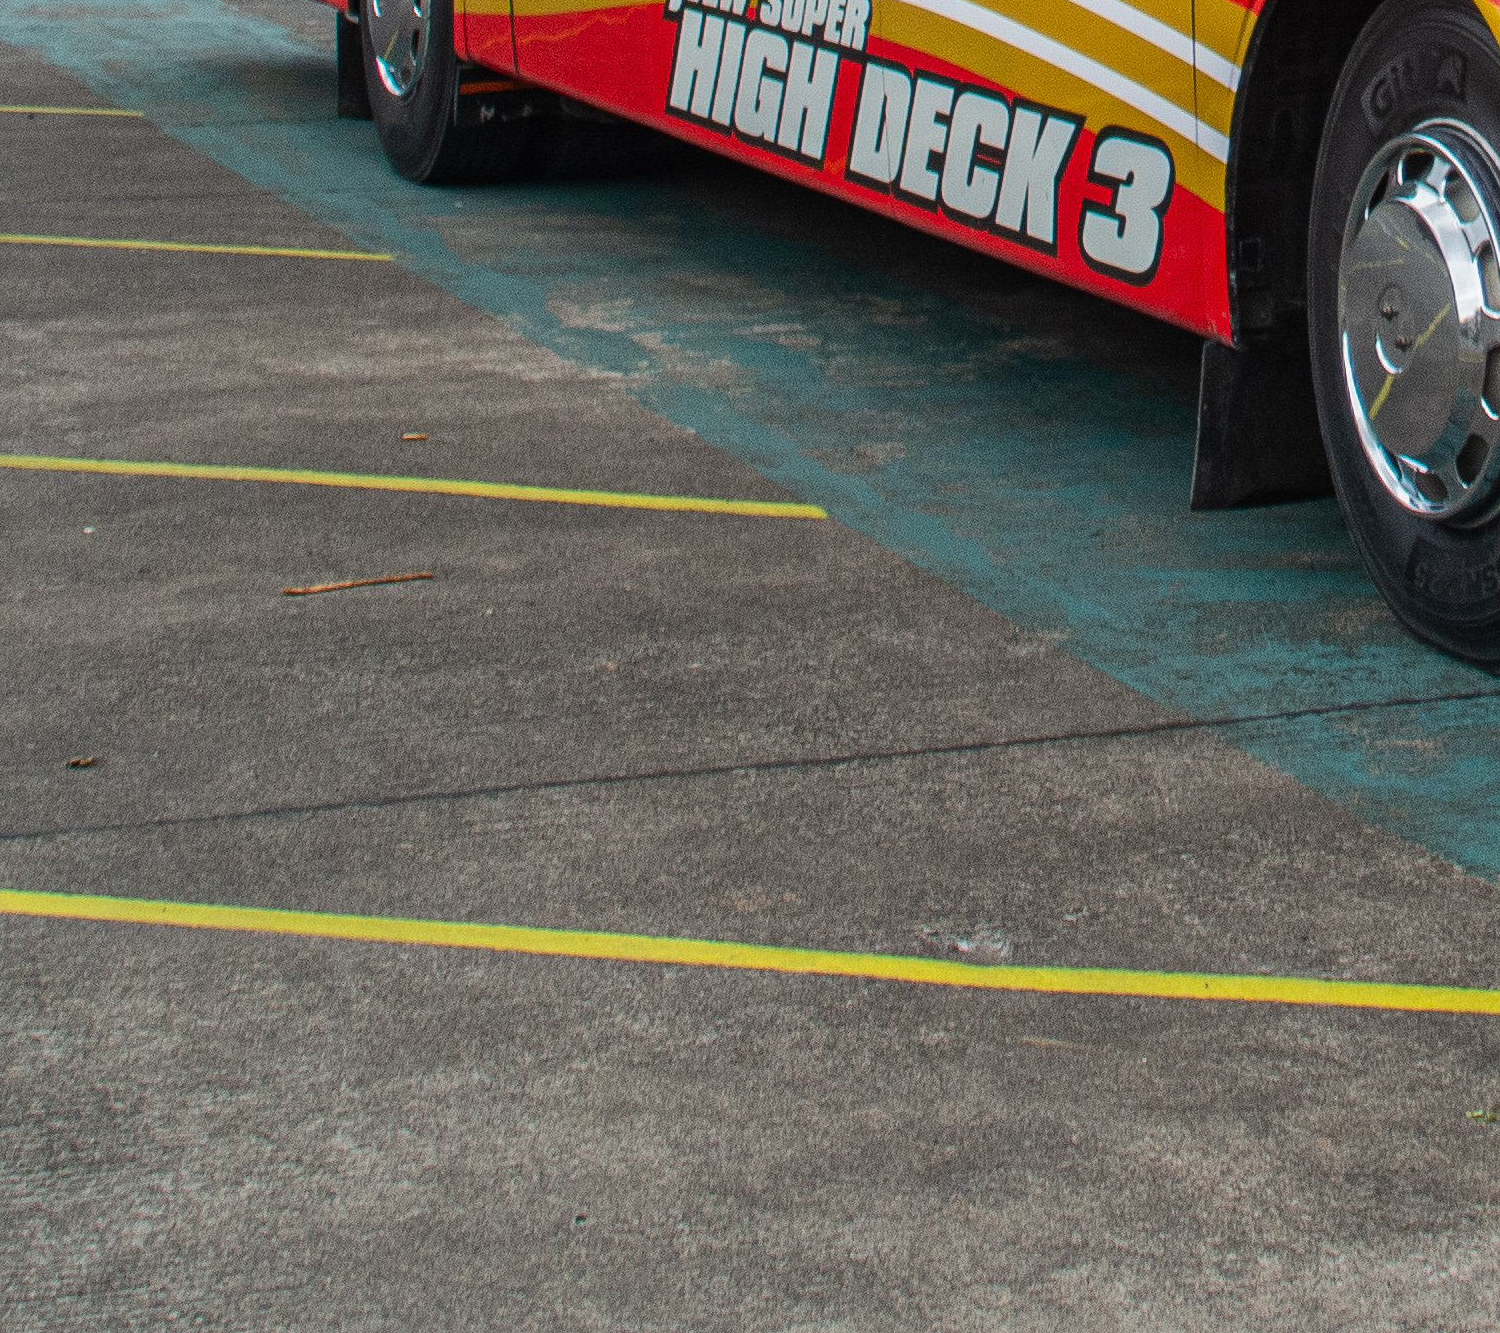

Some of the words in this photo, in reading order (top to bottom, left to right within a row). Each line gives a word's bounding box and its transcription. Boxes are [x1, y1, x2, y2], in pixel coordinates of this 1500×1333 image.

[666, 10, 840, 168] HIGH
[846, 60, 1087, 256] DECK
[1080, 125, 1176, 286] 3
